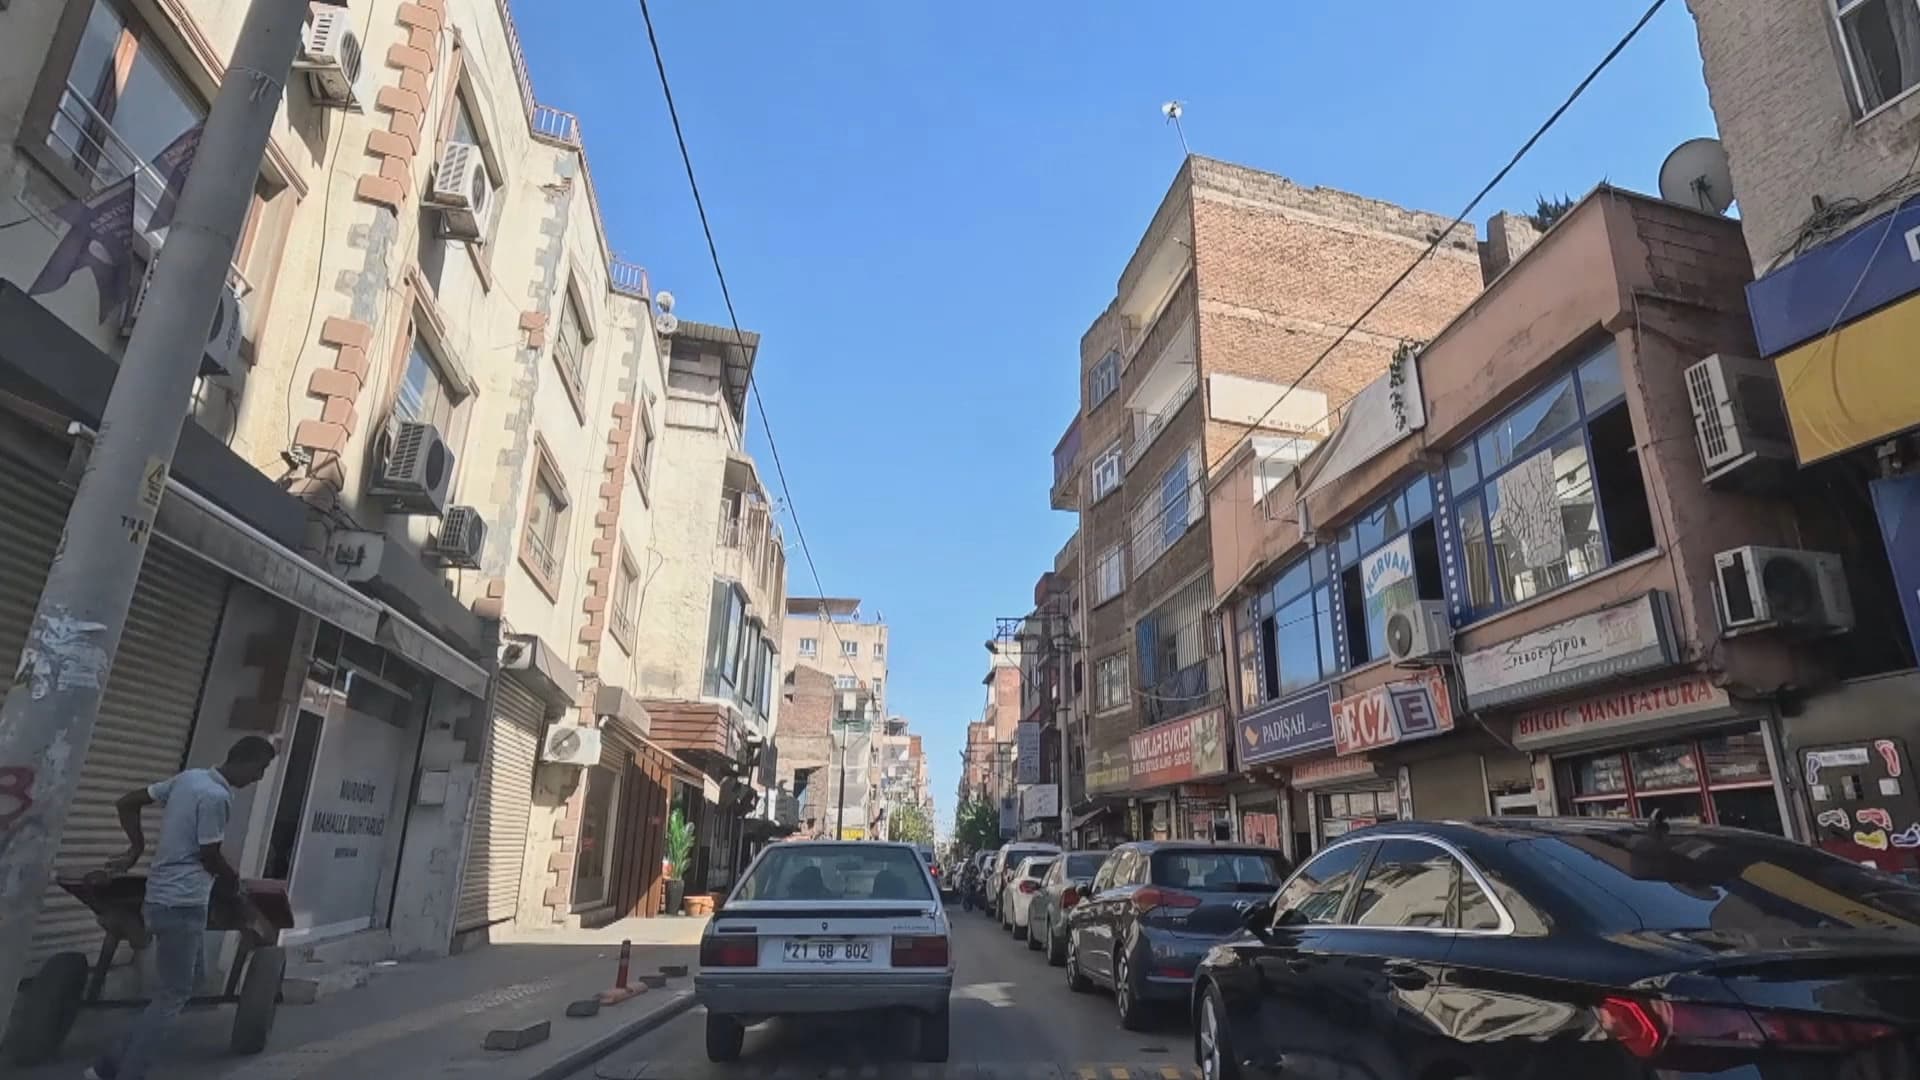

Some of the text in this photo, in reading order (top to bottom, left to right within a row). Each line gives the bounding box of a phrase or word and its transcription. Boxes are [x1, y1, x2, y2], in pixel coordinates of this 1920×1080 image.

[1366, 551, 1409, 594] KERVAN
[1579, 679, 1714, 723] MANİFATURA
[1163, 725, 1191, 753] EVKUR
[1262, 712, 1306, 744] PADİŞAH
[792, 943, 808, 959] 21
[818, 943, 834, 959] GB
[845, 943, 869, 959] 802
